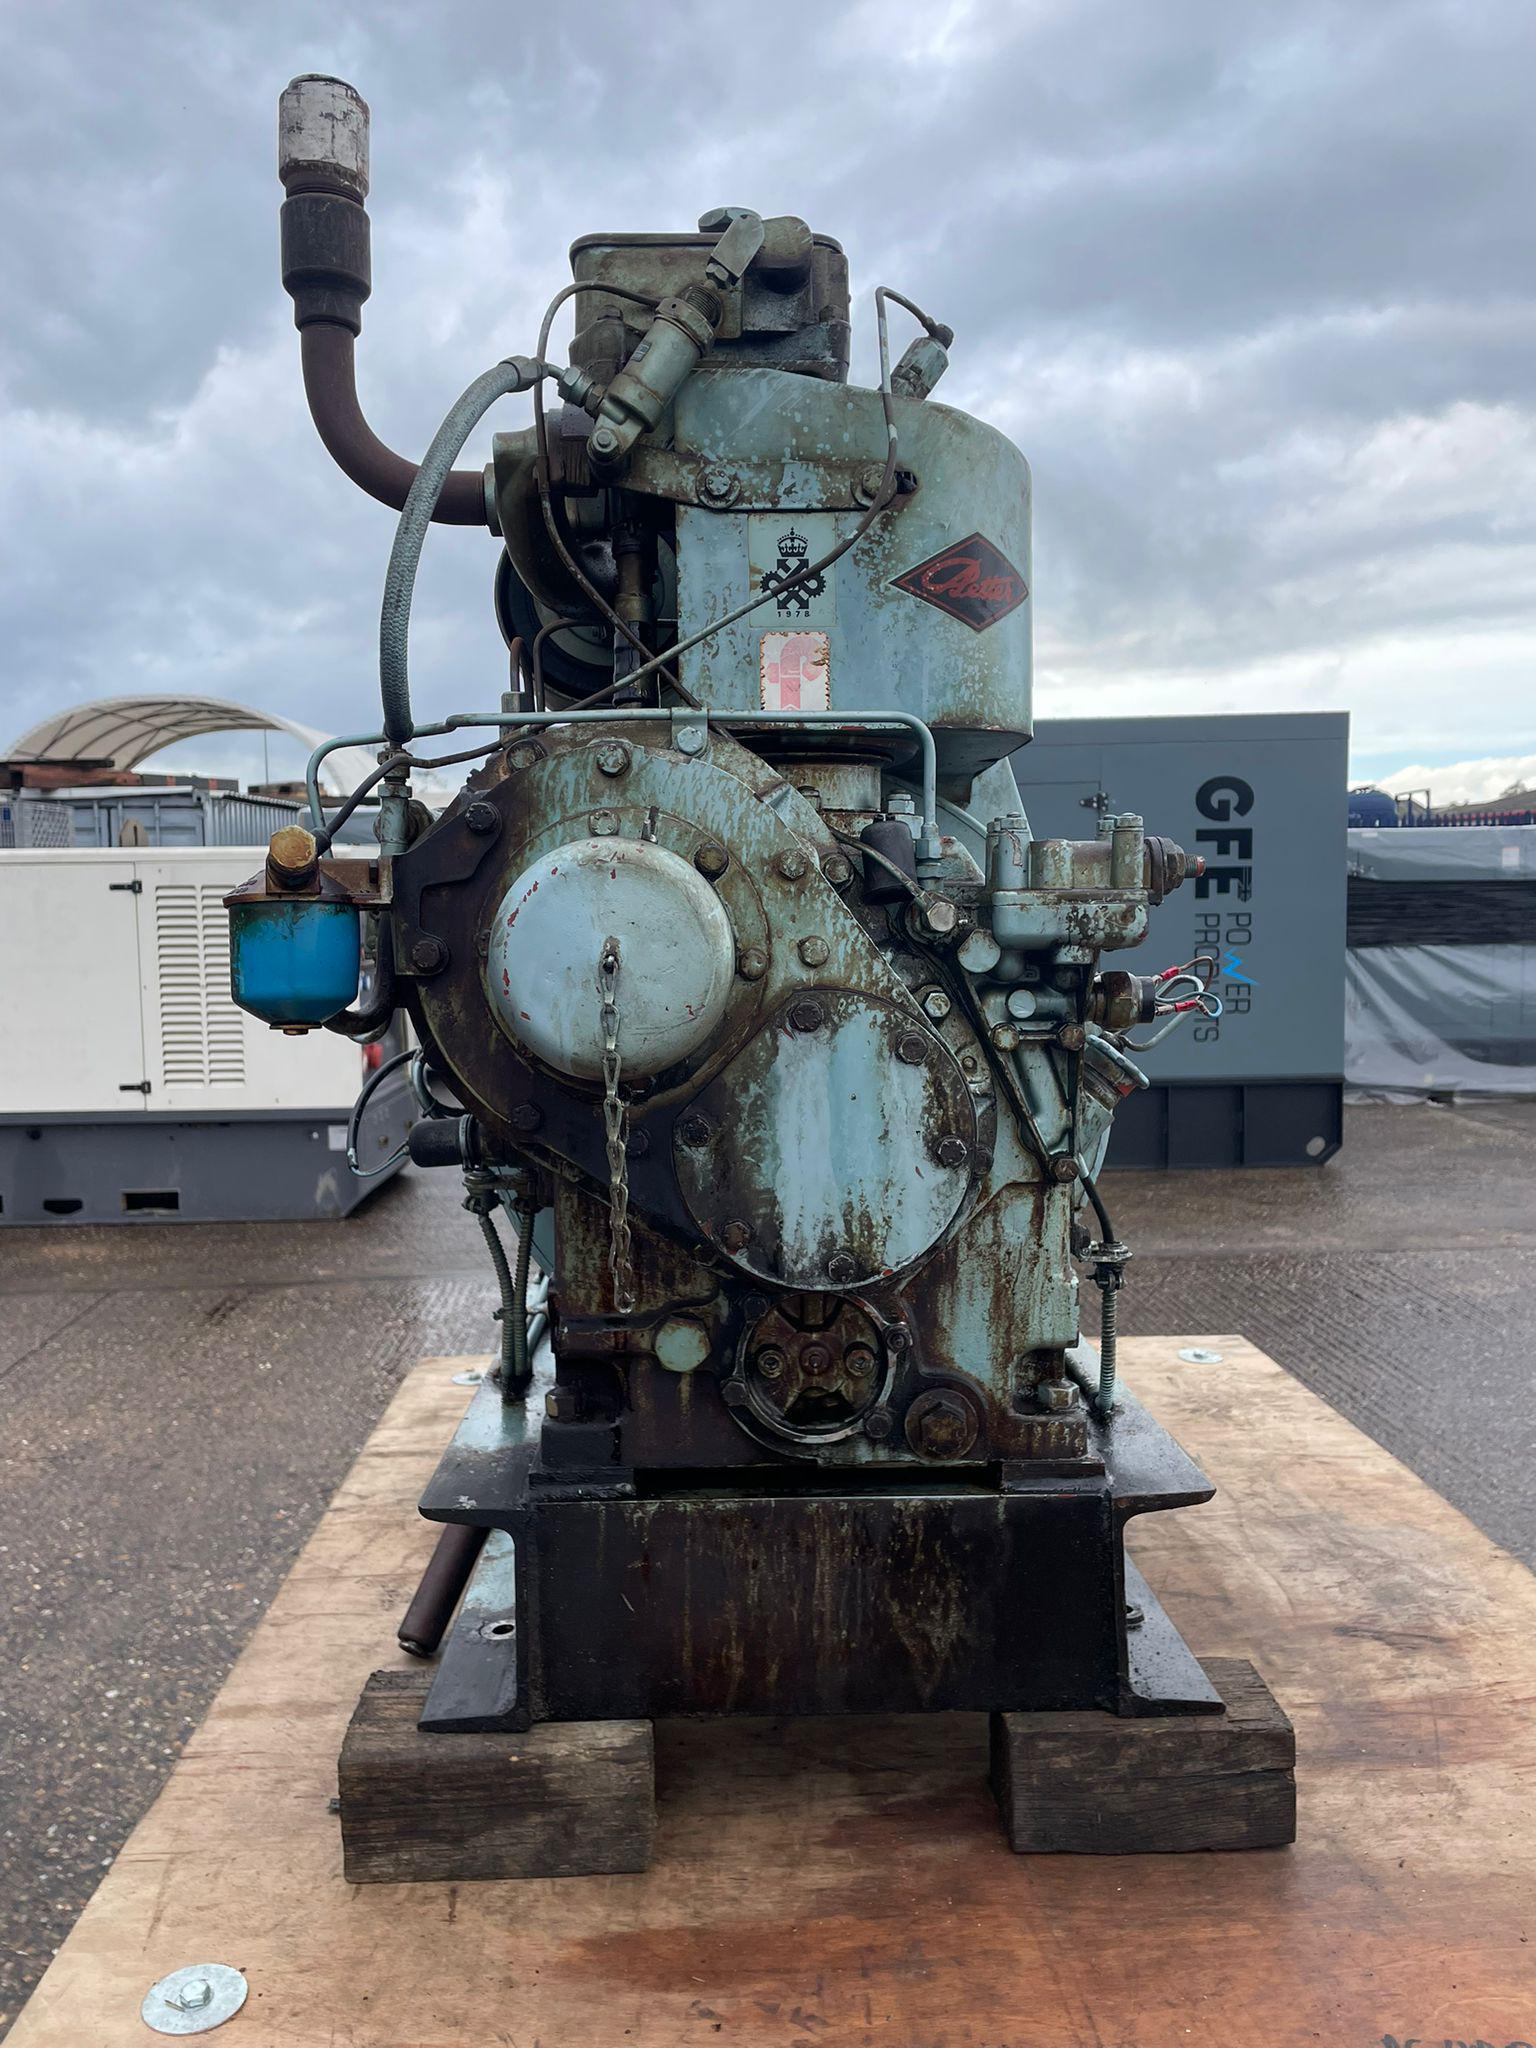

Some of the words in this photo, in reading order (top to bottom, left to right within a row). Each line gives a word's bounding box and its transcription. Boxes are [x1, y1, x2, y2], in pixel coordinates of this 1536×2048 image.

[777, 610, 810, 618] 1978
[1195, 775, 1254, 902] GFE
[1223, 912, 1259, 1014] POWER
